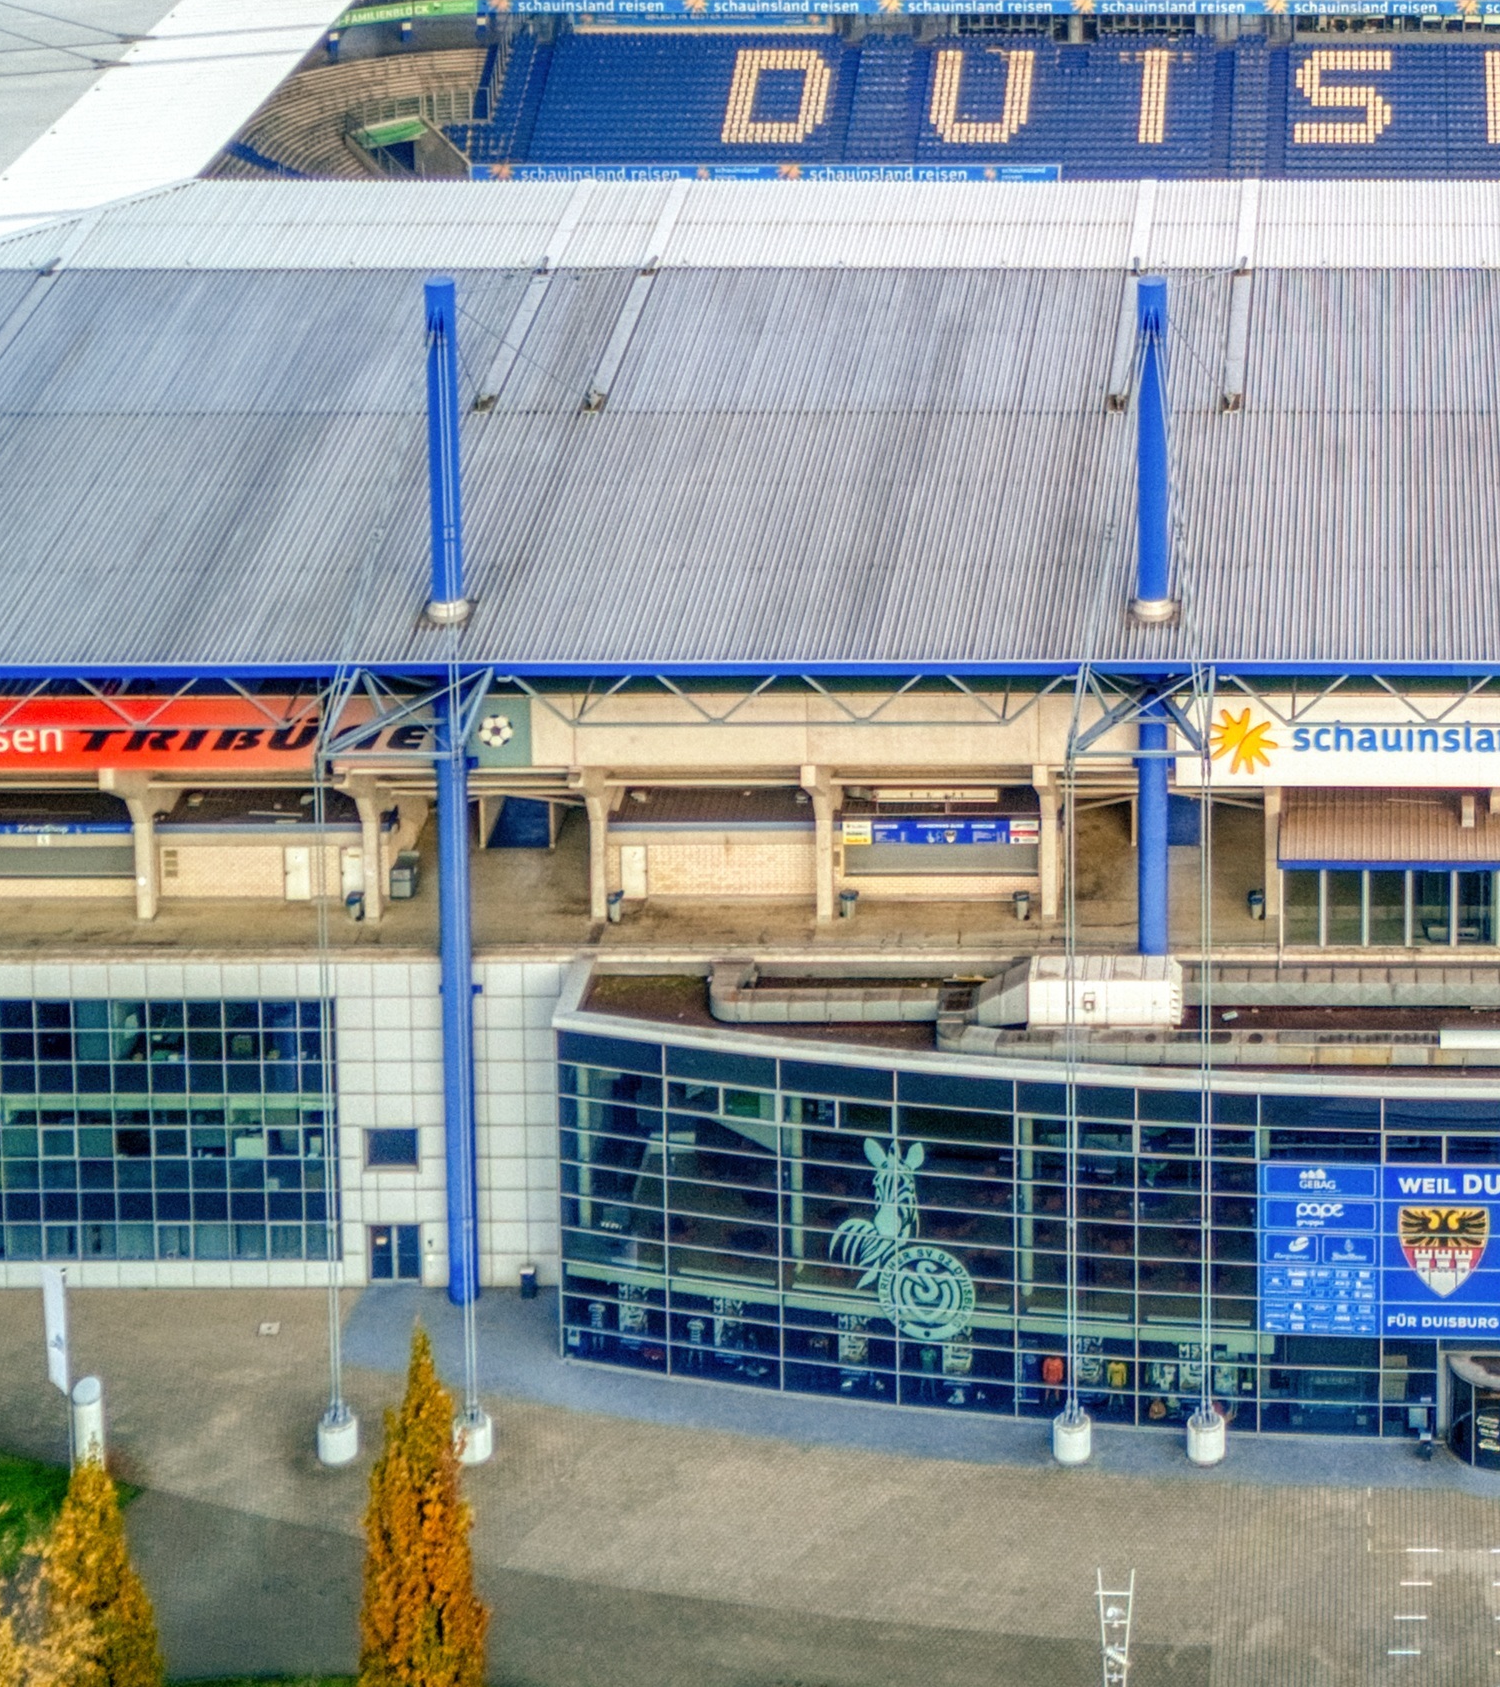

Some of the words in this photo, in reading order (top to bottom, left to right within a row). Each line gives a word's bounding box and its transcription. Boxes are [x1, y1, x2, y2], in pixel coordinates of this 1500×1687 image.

[714, 0, 809, 13] schauinsland
[814, 0, 859, 13] reisen
[908, 0, 1003, 14] schauinsland
[1009, 0, 1053, 14] reisen
[1101, 0, 1196, 14] schauinsland
[1201, 0, 1246, 14] reisen
[1294, 0, 1388, 14] schauinsland
[1393, 0, 1438, 14] reisen
[521, 167, 625, 181] schauinsland
[631, 167, 680, 181] reisen
[810, 167, 913, 181] schauinsland
[919, 167, 967, 181] reisen
[1298, 1179, 1337, 1190] GEBAG
[1398, 1177, 1456, 1194] WEIL
[1296, 1202, 1345, 1219] pape
[1386, 1313, 1417, 1328] FÜR
[1421, 1315, 1500, 1329] DUISBURG
